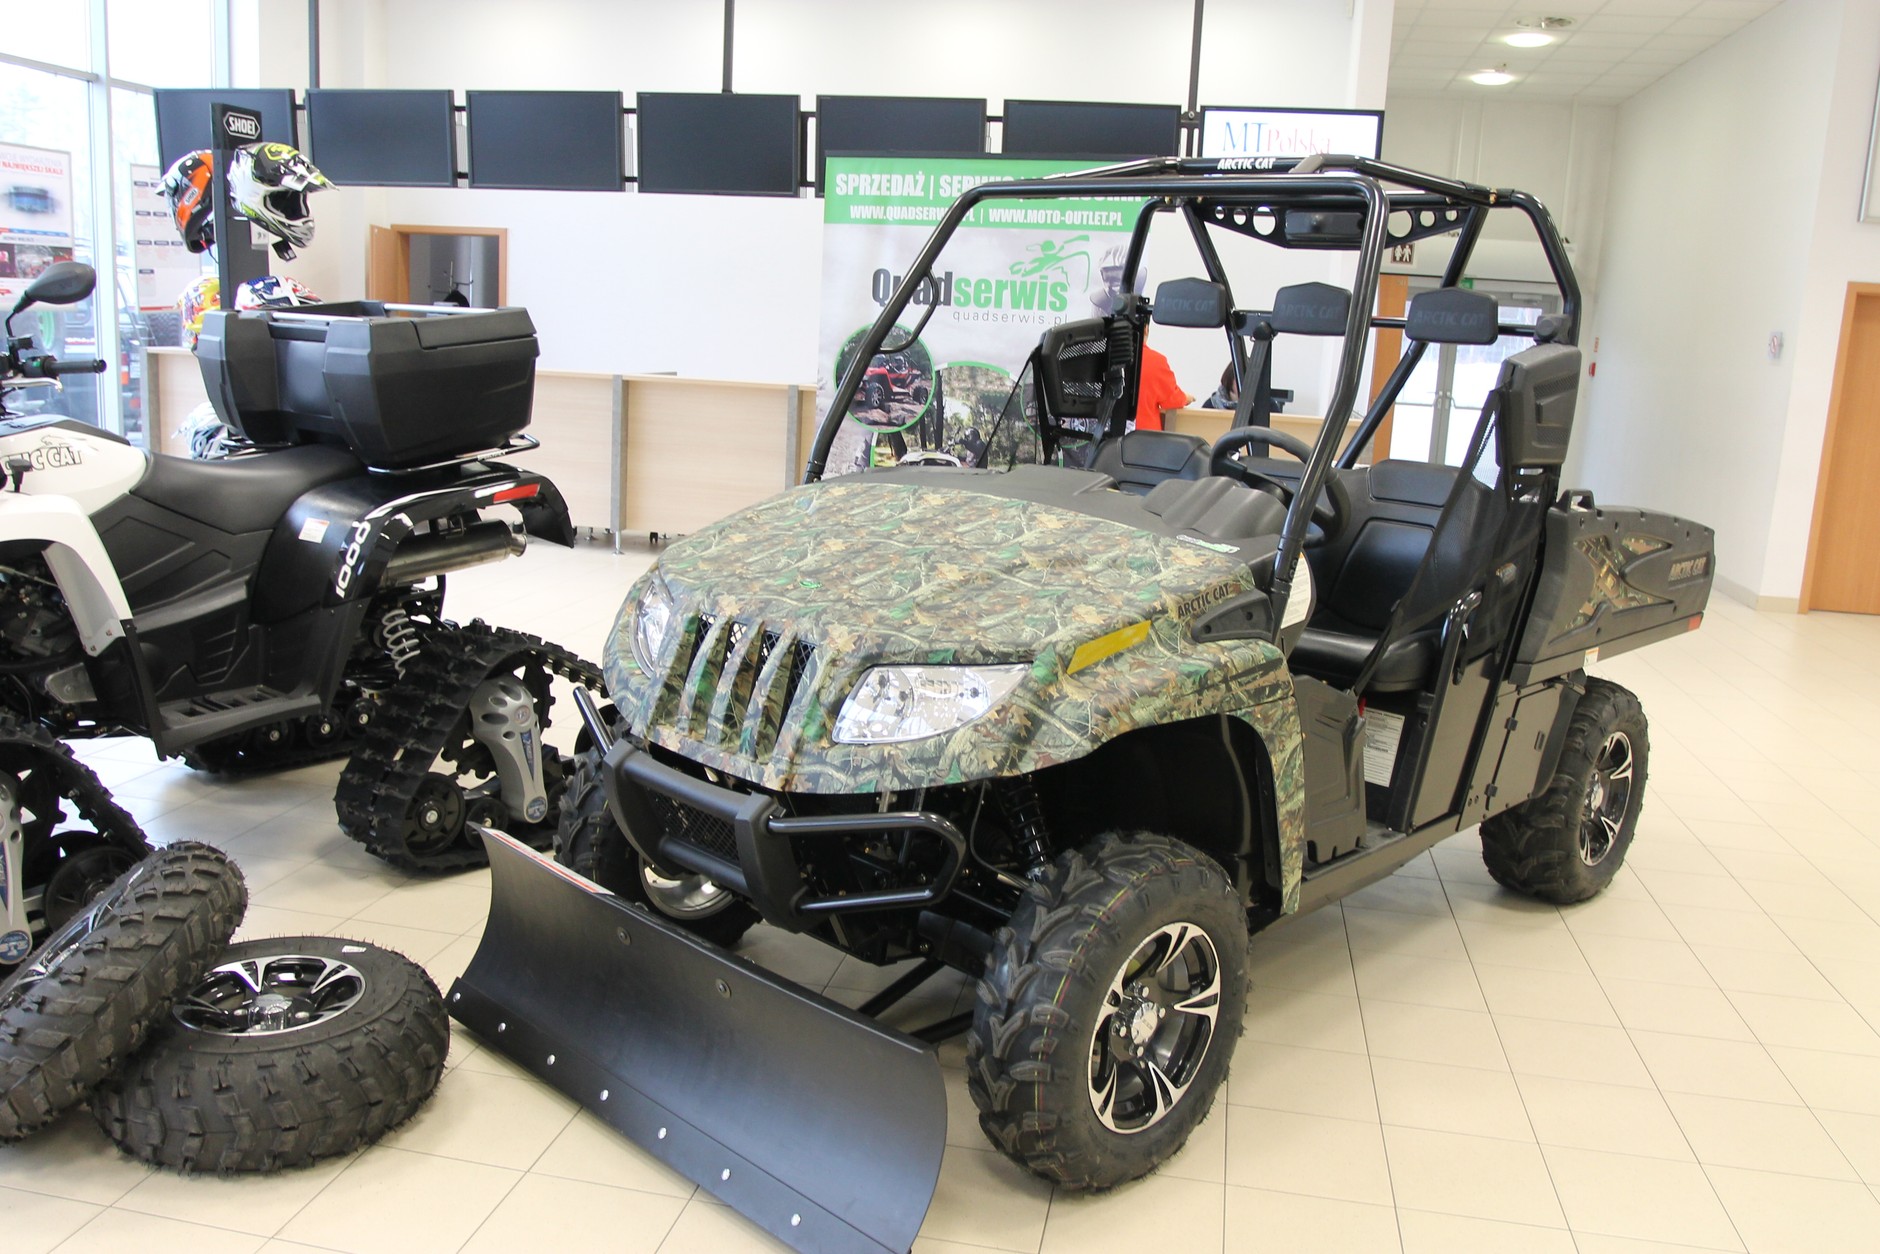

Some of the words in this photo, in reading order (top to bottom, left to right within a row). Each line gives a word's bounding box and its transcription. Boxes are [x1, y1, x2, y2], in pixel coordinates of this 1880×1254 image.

[228, 114, 256, 136] SHOEI
[1217, 158, 1253, 170] ARCTIC
[1255, 157, 1277, 169] CAT
[836, 171, 926, 197] SPRZEDAŻ
[850, 205, 975, 222] WWW.QUADSERW.PL
[988, 207, 1123, 226] WWW.MOTO-OUTLET.PL
[952, 310, 1068, 325] quadserwis.pl
[46, 446, 82, 468] CAT
[1668, 560, 1693, 582] ARCTIC
[1692, 557, 1707, 575] CAT
[1178, 592, 1211, 618] ARCTIC
[1213, 582, 1230, 601] CAT
